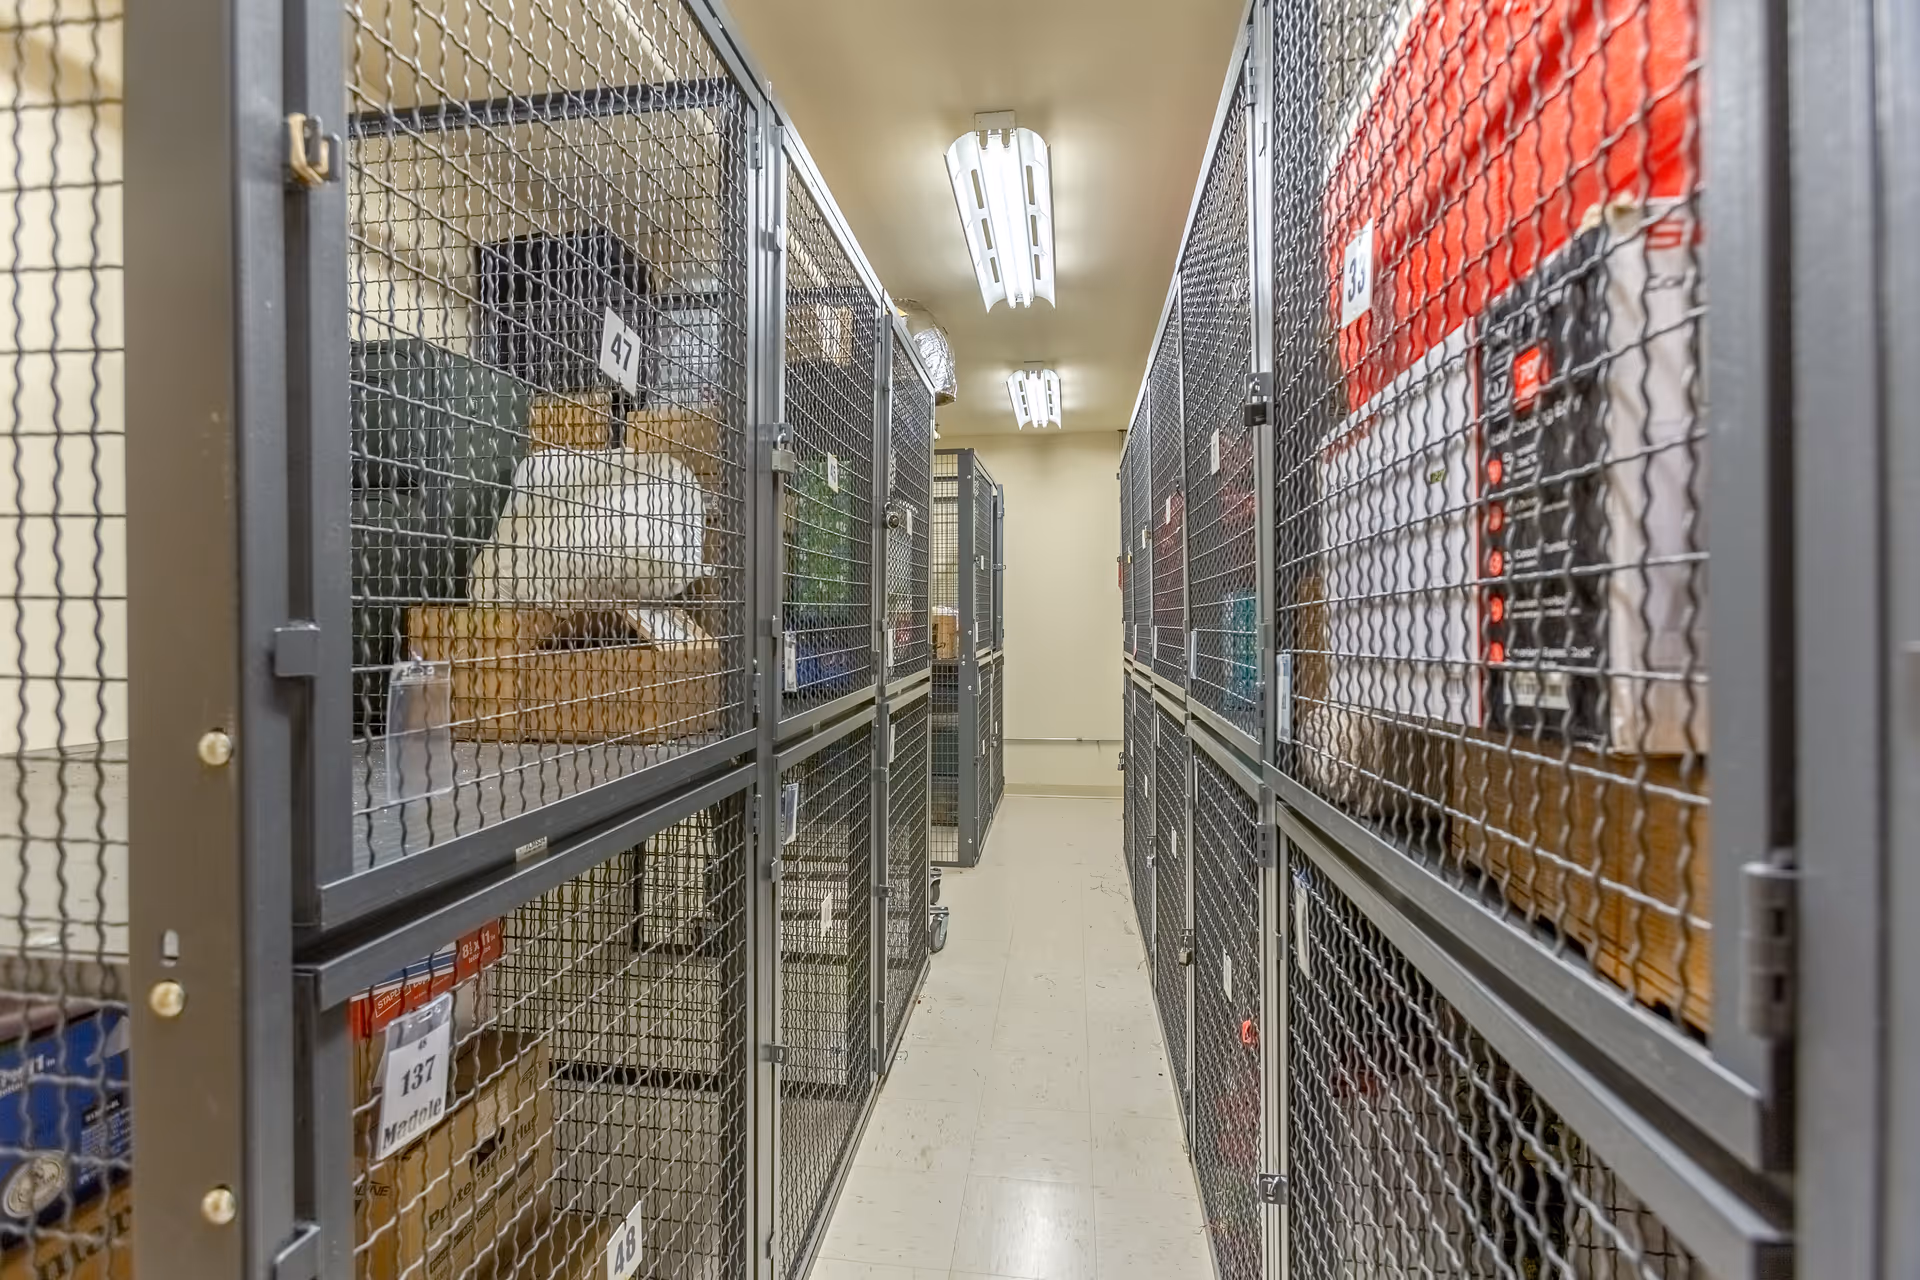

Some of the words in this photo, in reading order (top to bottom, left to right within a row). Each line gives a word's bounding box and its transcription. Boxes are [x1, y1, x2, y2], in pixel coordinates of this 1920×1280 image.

[611, 332, 632, 371] 47
[401, 1054, 436, 1097] 137
[382, 1097, 442, 1151] Madole
[614, 1225, 636, 1276] 48
